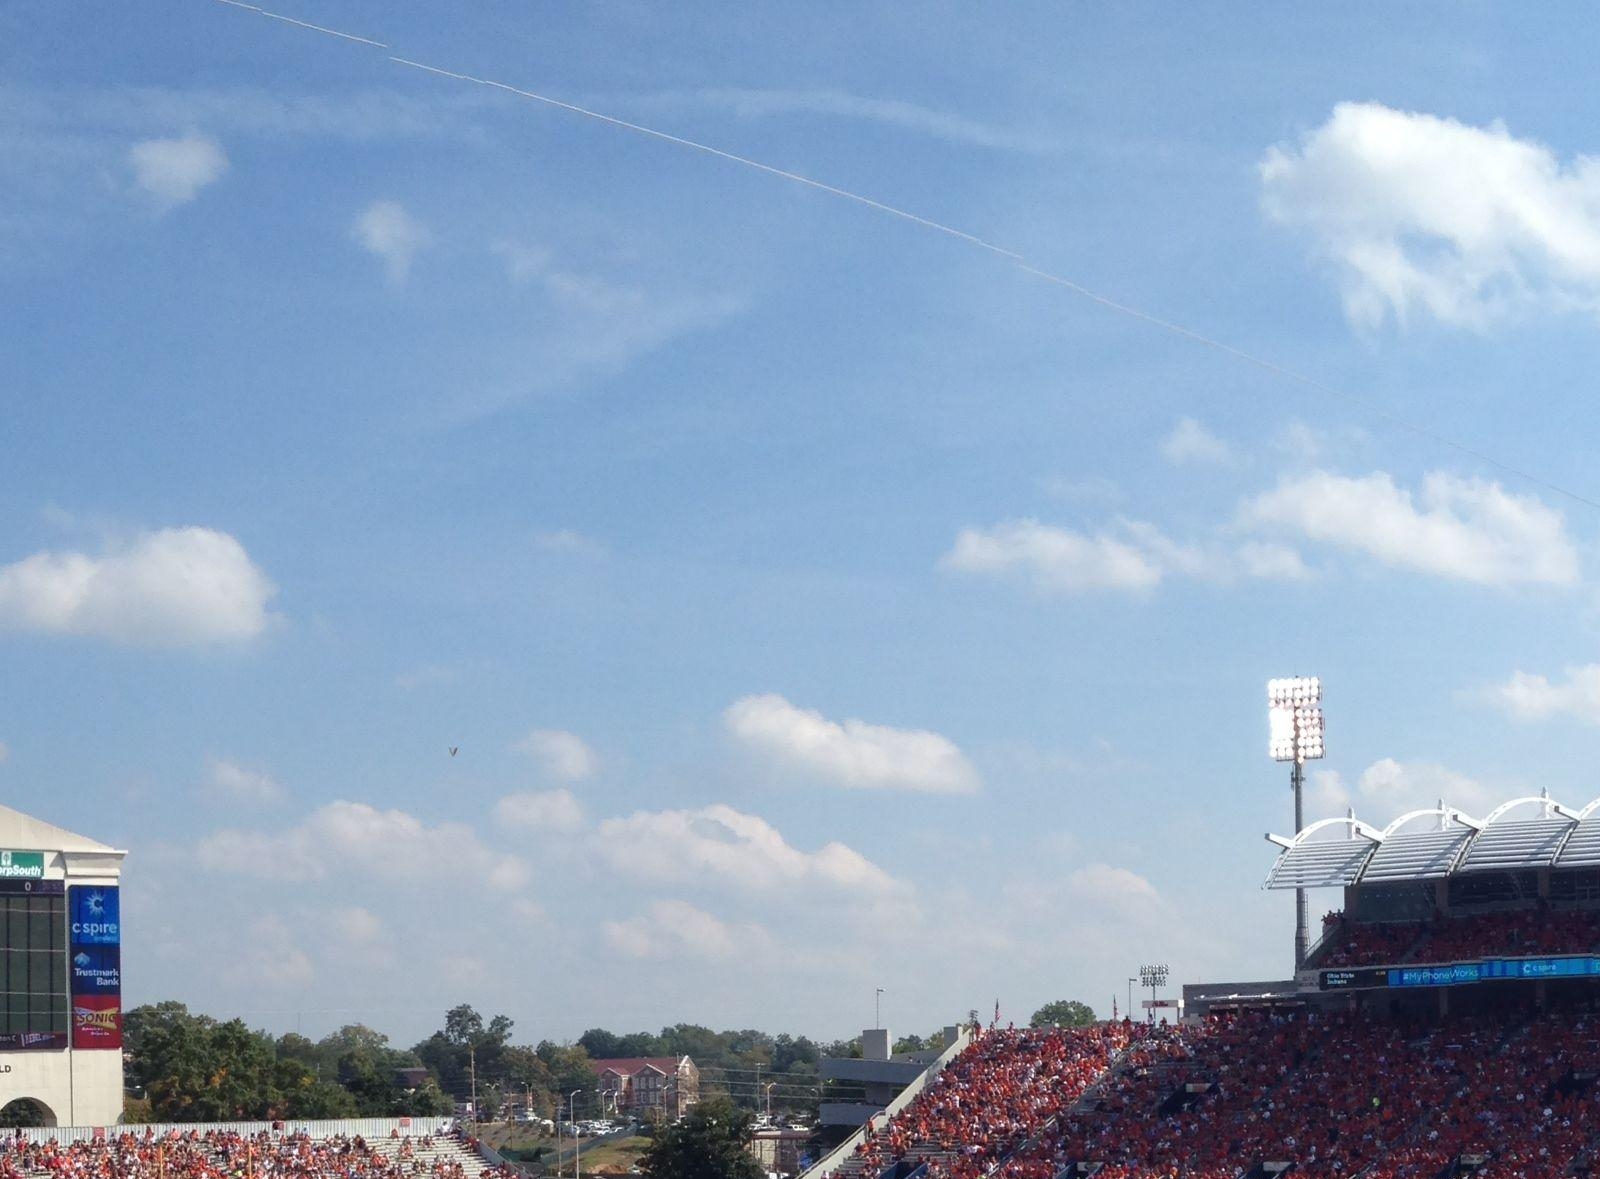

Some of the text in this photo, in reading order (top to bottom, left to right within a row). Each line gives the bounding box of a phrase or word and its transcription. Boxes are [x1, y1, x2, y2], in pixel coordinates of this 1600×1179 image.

[25, 882, 32, 891] 0
[83, 922, 118, 936] spire
[74, 967, 119, 977] Trustmark
[1403, 968, 1479, 982] #MyPhoneWorks
[96, 977, 119, 986] Bank
[79, 1013, 116, 1024] SONIC
